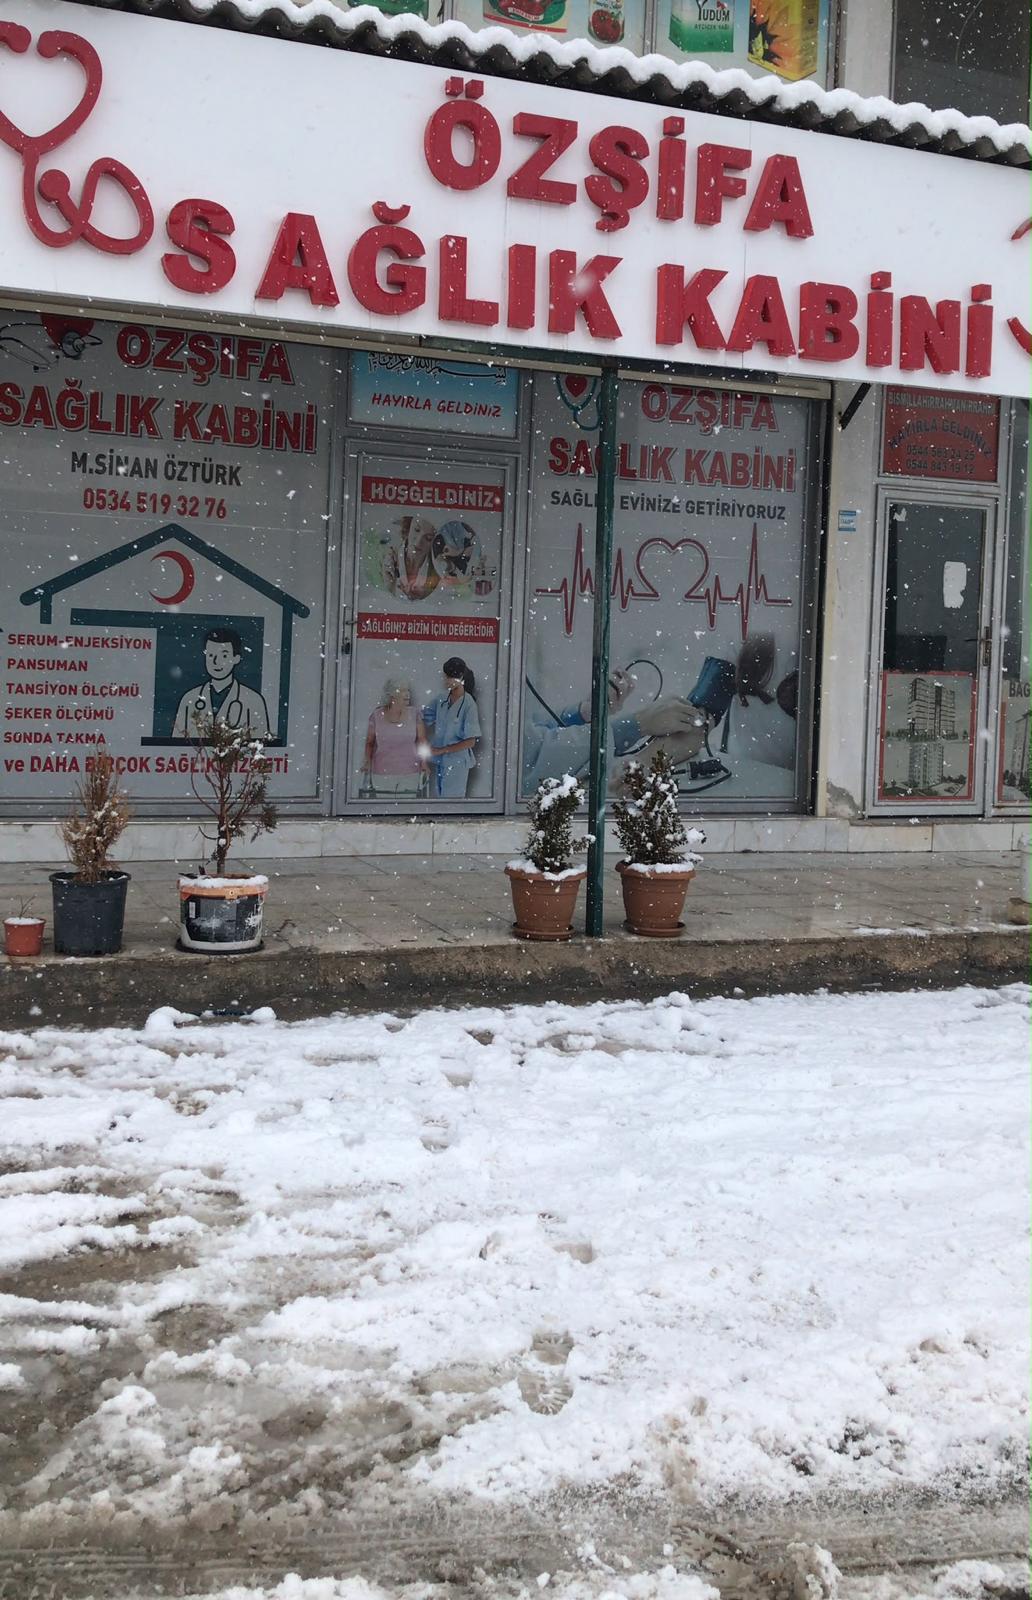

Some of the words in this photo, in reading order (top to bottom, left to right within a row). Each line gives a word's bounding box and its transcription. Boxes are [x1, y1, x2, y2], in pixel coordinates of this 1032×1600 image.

[424, 76, 814, 241] ÖZŞİFA
[161, 198, 624, 341] SAĞLIK
[655, 262, 994, 379] KABİNİ
[0, 377, 163, 439] SAĞLIK
[172, 398, 318, 454] KABİNİ
[371, 393, 432, 411] HAYIRLA
[71, 449, 159, 480] M.SİNAN
[164, 454, 243, 487] ÖZTÜRK
[548, 436, 676, 483] SALIK
[684, 446, 796, 493] KABİNİ
[83, 487, 131, 513] 0534
[136, 491, 172, 515] 519
[176, 495, 200, 518] 32
[204, 497, 228, 520] 76
[371, 482, 495, 509] HOŞGELDİNİZ
[620, 493, 681, 515] EVİNİZE
[685, 499, 786, 521] GETİRİYORUZ
[7, 633, 152, 650] SERUM-ENJEKSİYON
[7, 658, 88, 671] PANSUMAN
[6, 681, 77, 695] TANSİYON
[82, 682, 140, 698] ÖLÇÜMÜ
[4, 707, 52, 720] ŞEKER
[56, 705, 114, 721] ÖLÇÜMÜ
[3, 732, 52, 744] SONDA
[57, 733, 106, 744] TAKMA
[4, 758, 25, 772] ve
[30, 756, 79, 773] DAHA
